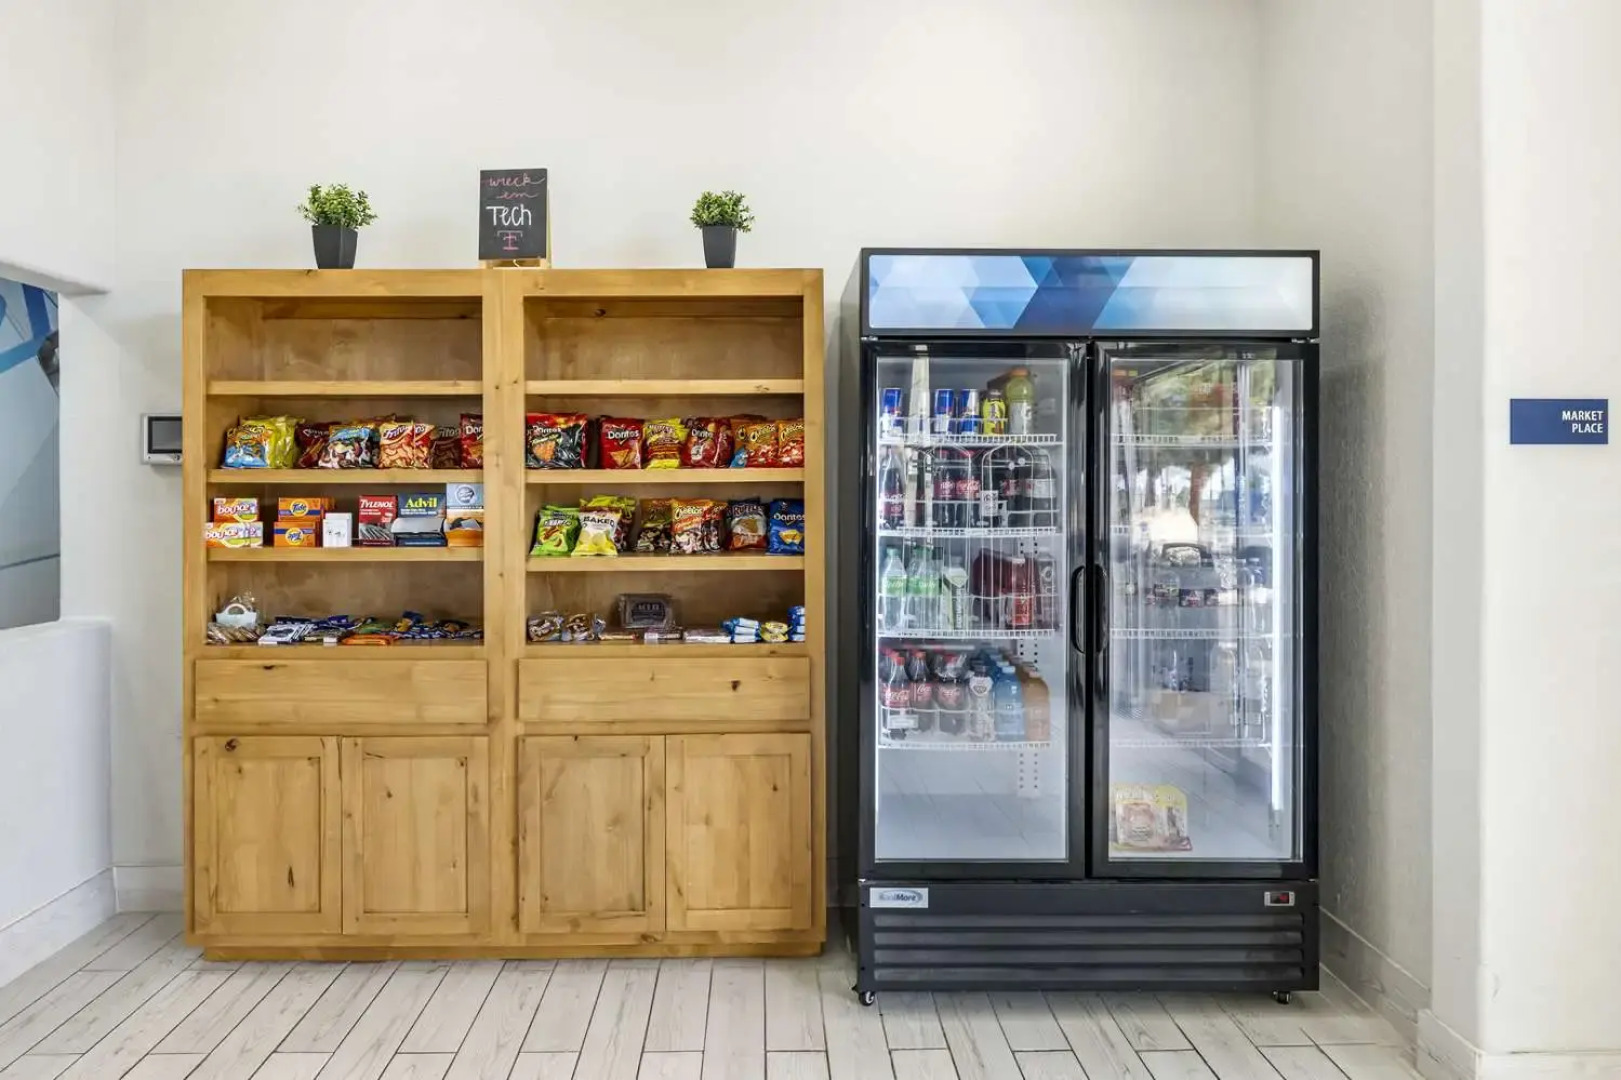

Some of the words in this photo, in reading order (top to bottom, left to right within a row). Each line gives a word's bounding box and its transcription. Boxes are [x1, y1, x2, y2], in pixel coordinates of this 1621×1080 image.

[489, 173, 545, 187] wreck
[1562, 410, 1603, 421] MARKET
[1572, 423, 1603, 433] PLACE
[608, 430, 640, 440] Doritos
[360, 499, 394, 508] TYLENOL
[404, 497, 438, 508] Advil
[583, 516, 615, 527] BAKED
